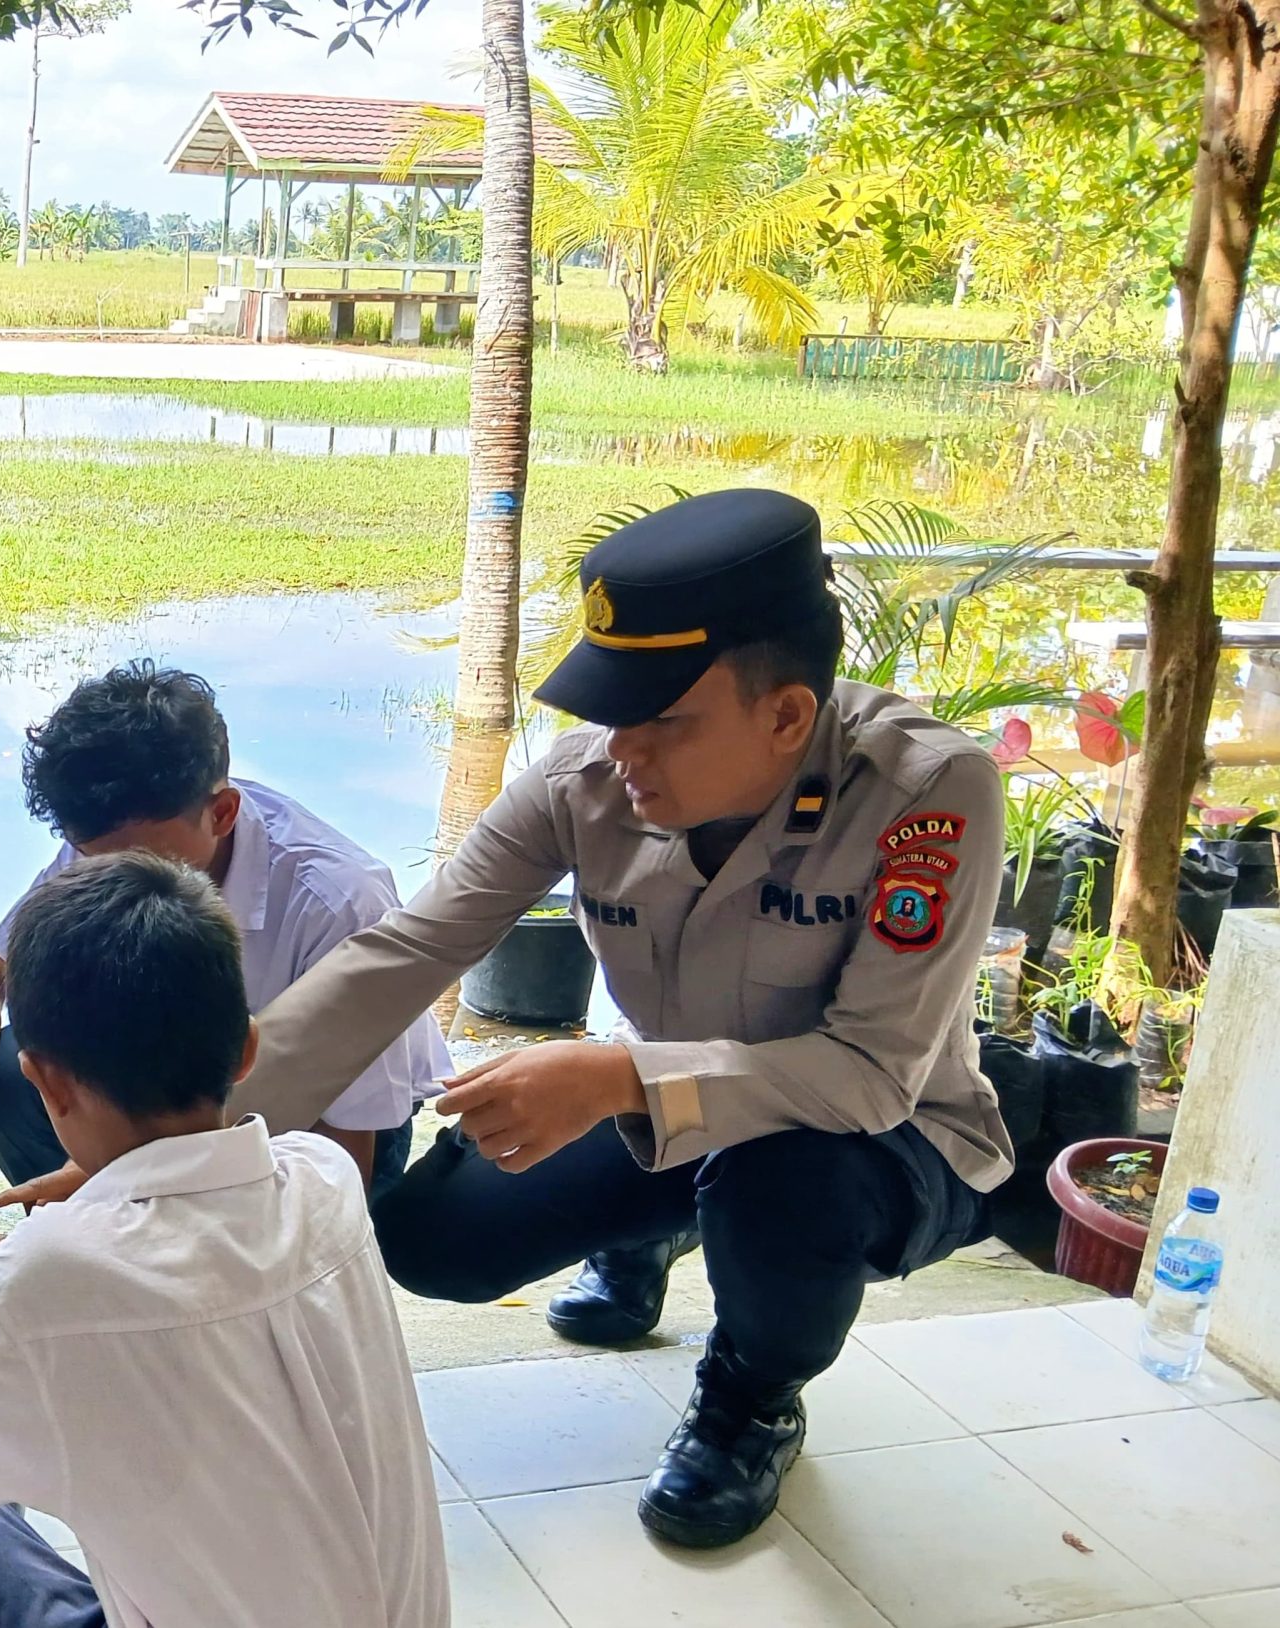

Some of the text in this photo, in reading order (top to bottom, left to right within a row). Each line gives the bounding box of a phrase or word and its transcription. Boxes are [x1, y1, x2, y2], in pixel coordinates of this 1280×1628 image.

[887, 820, 953, 849] POLDA
[889, 853, 949, 871] SUMATERA UTARA
